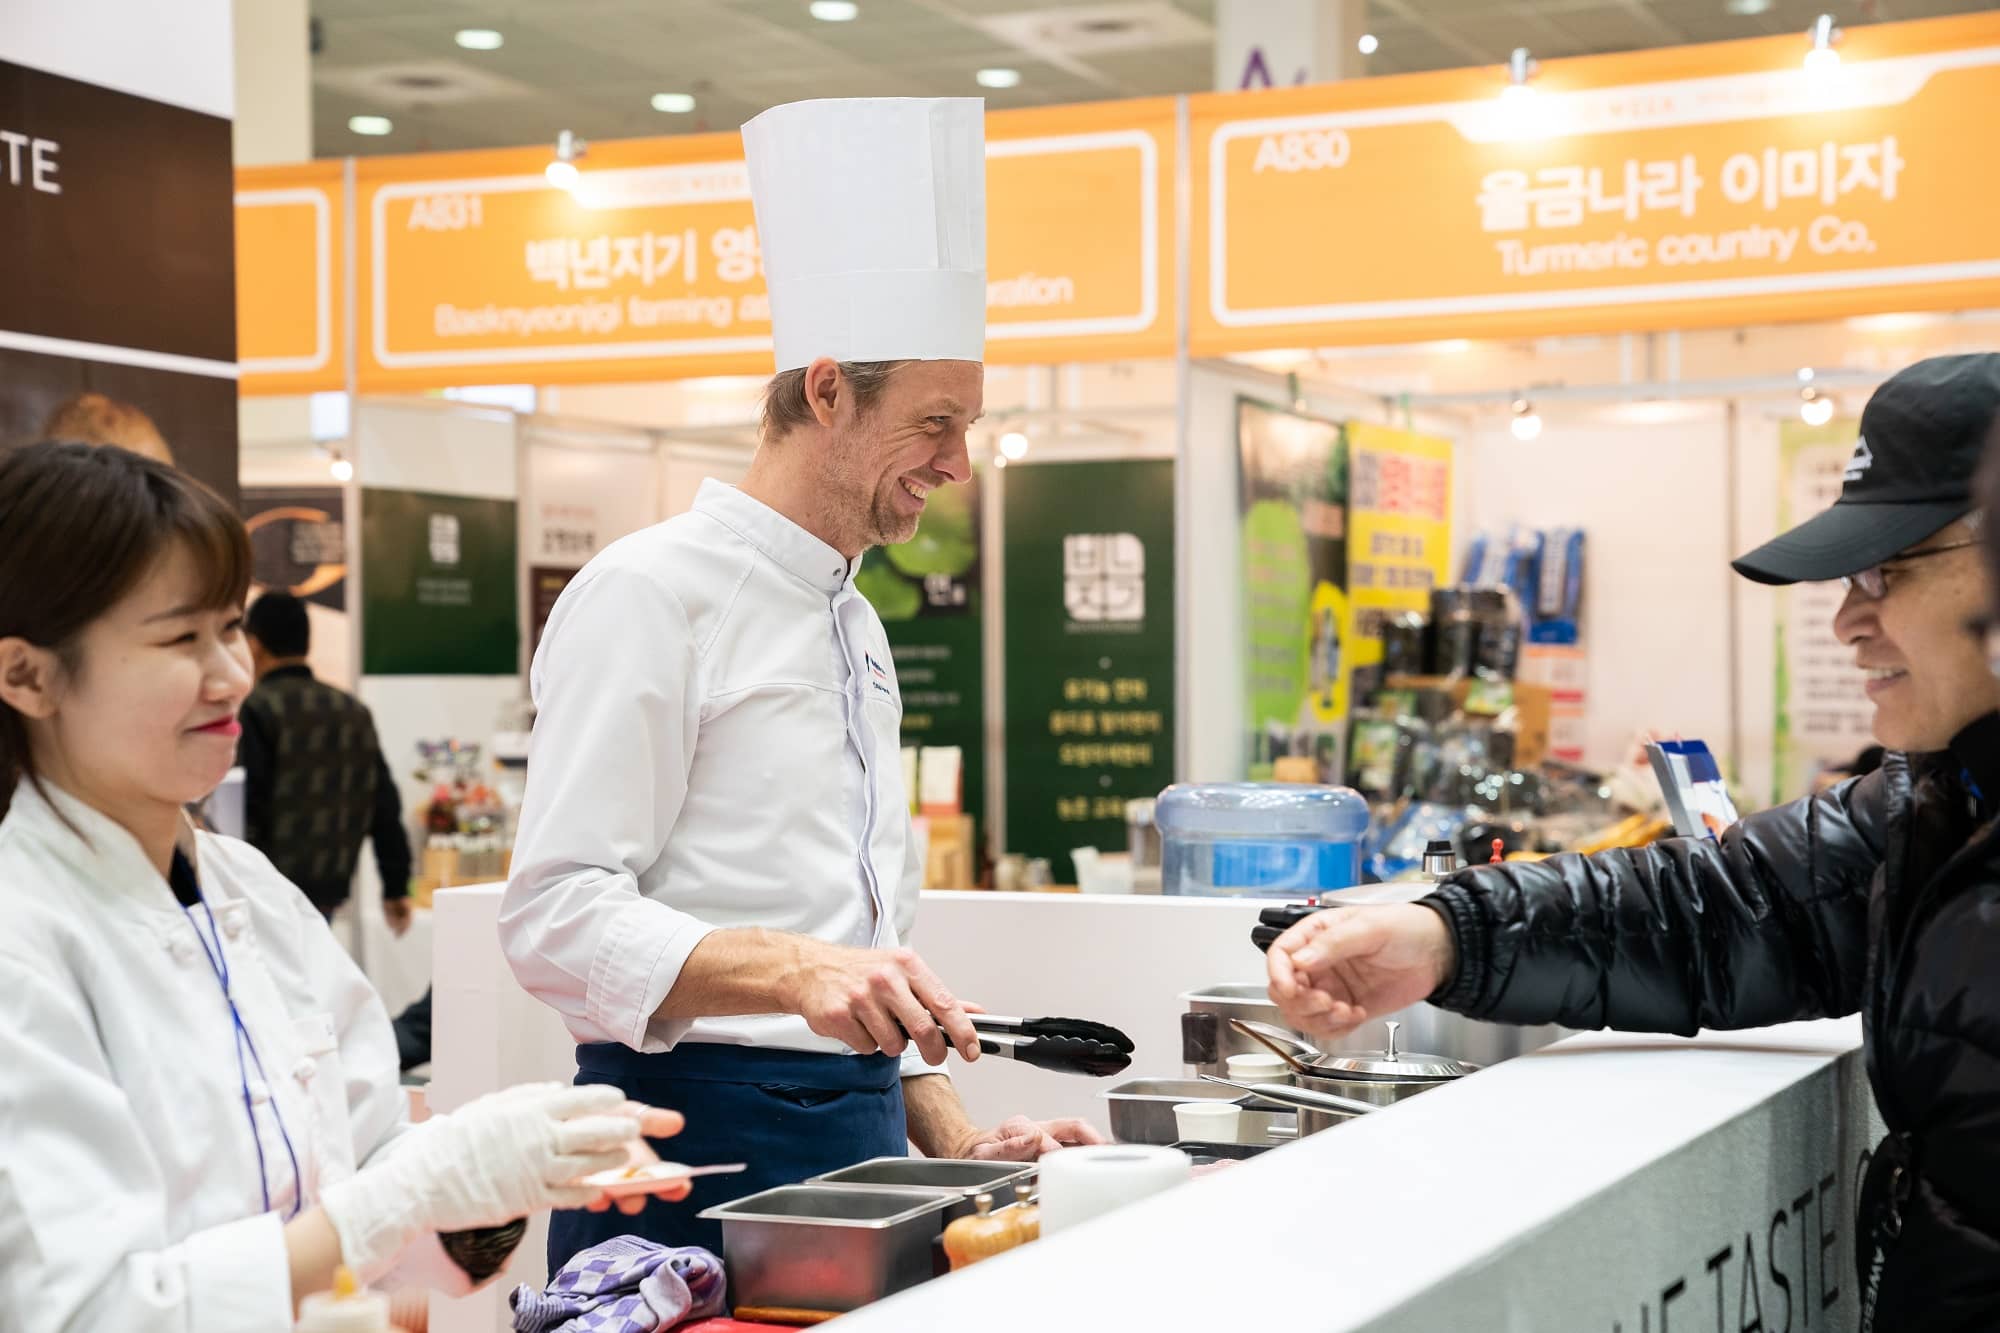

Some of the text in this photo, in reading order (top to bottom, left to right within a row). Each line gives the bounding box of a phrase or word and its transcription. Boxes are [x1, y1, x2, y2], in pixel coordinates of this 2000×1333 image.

[0, 129, 62, 195] TE
[1253, 129, 1351, 174] A830
[1721, 135, 1905, 211] 이미자
[1496, 214, 1877, 276] Turmeric country Co.
[1706, 1172, 1840, 1333] TASTE
